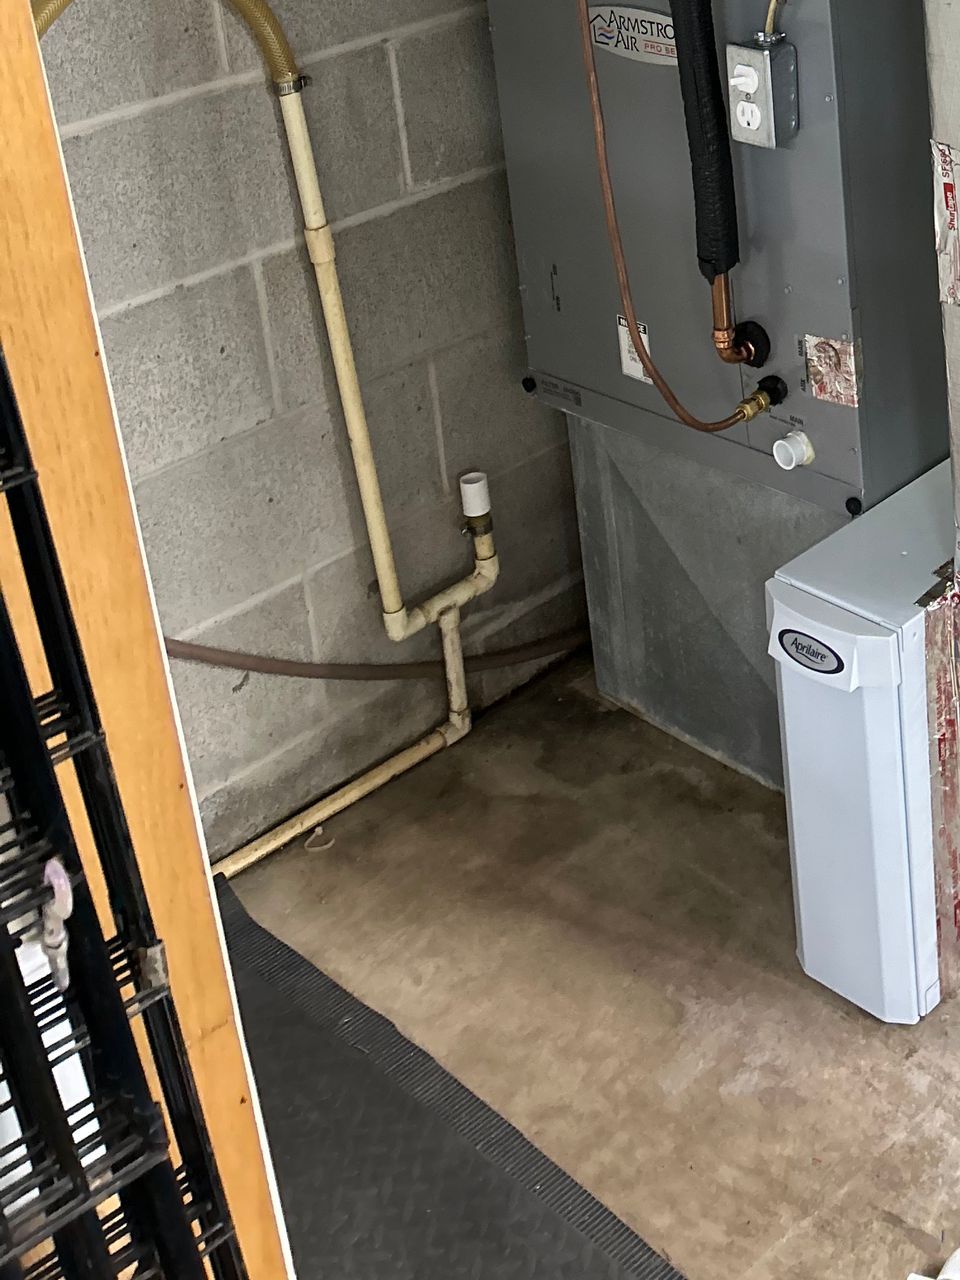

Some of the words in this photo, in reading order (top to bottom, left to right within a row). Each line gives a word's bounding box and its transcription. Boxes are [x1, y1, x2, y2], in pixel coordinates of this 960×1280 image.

[607, 10, 675, 39] ARMSTRO
[615, 30, 639, 52] AIR
[644, 43, 662, 53] PRO
[791, 637, 827, 663] Aprilaire
